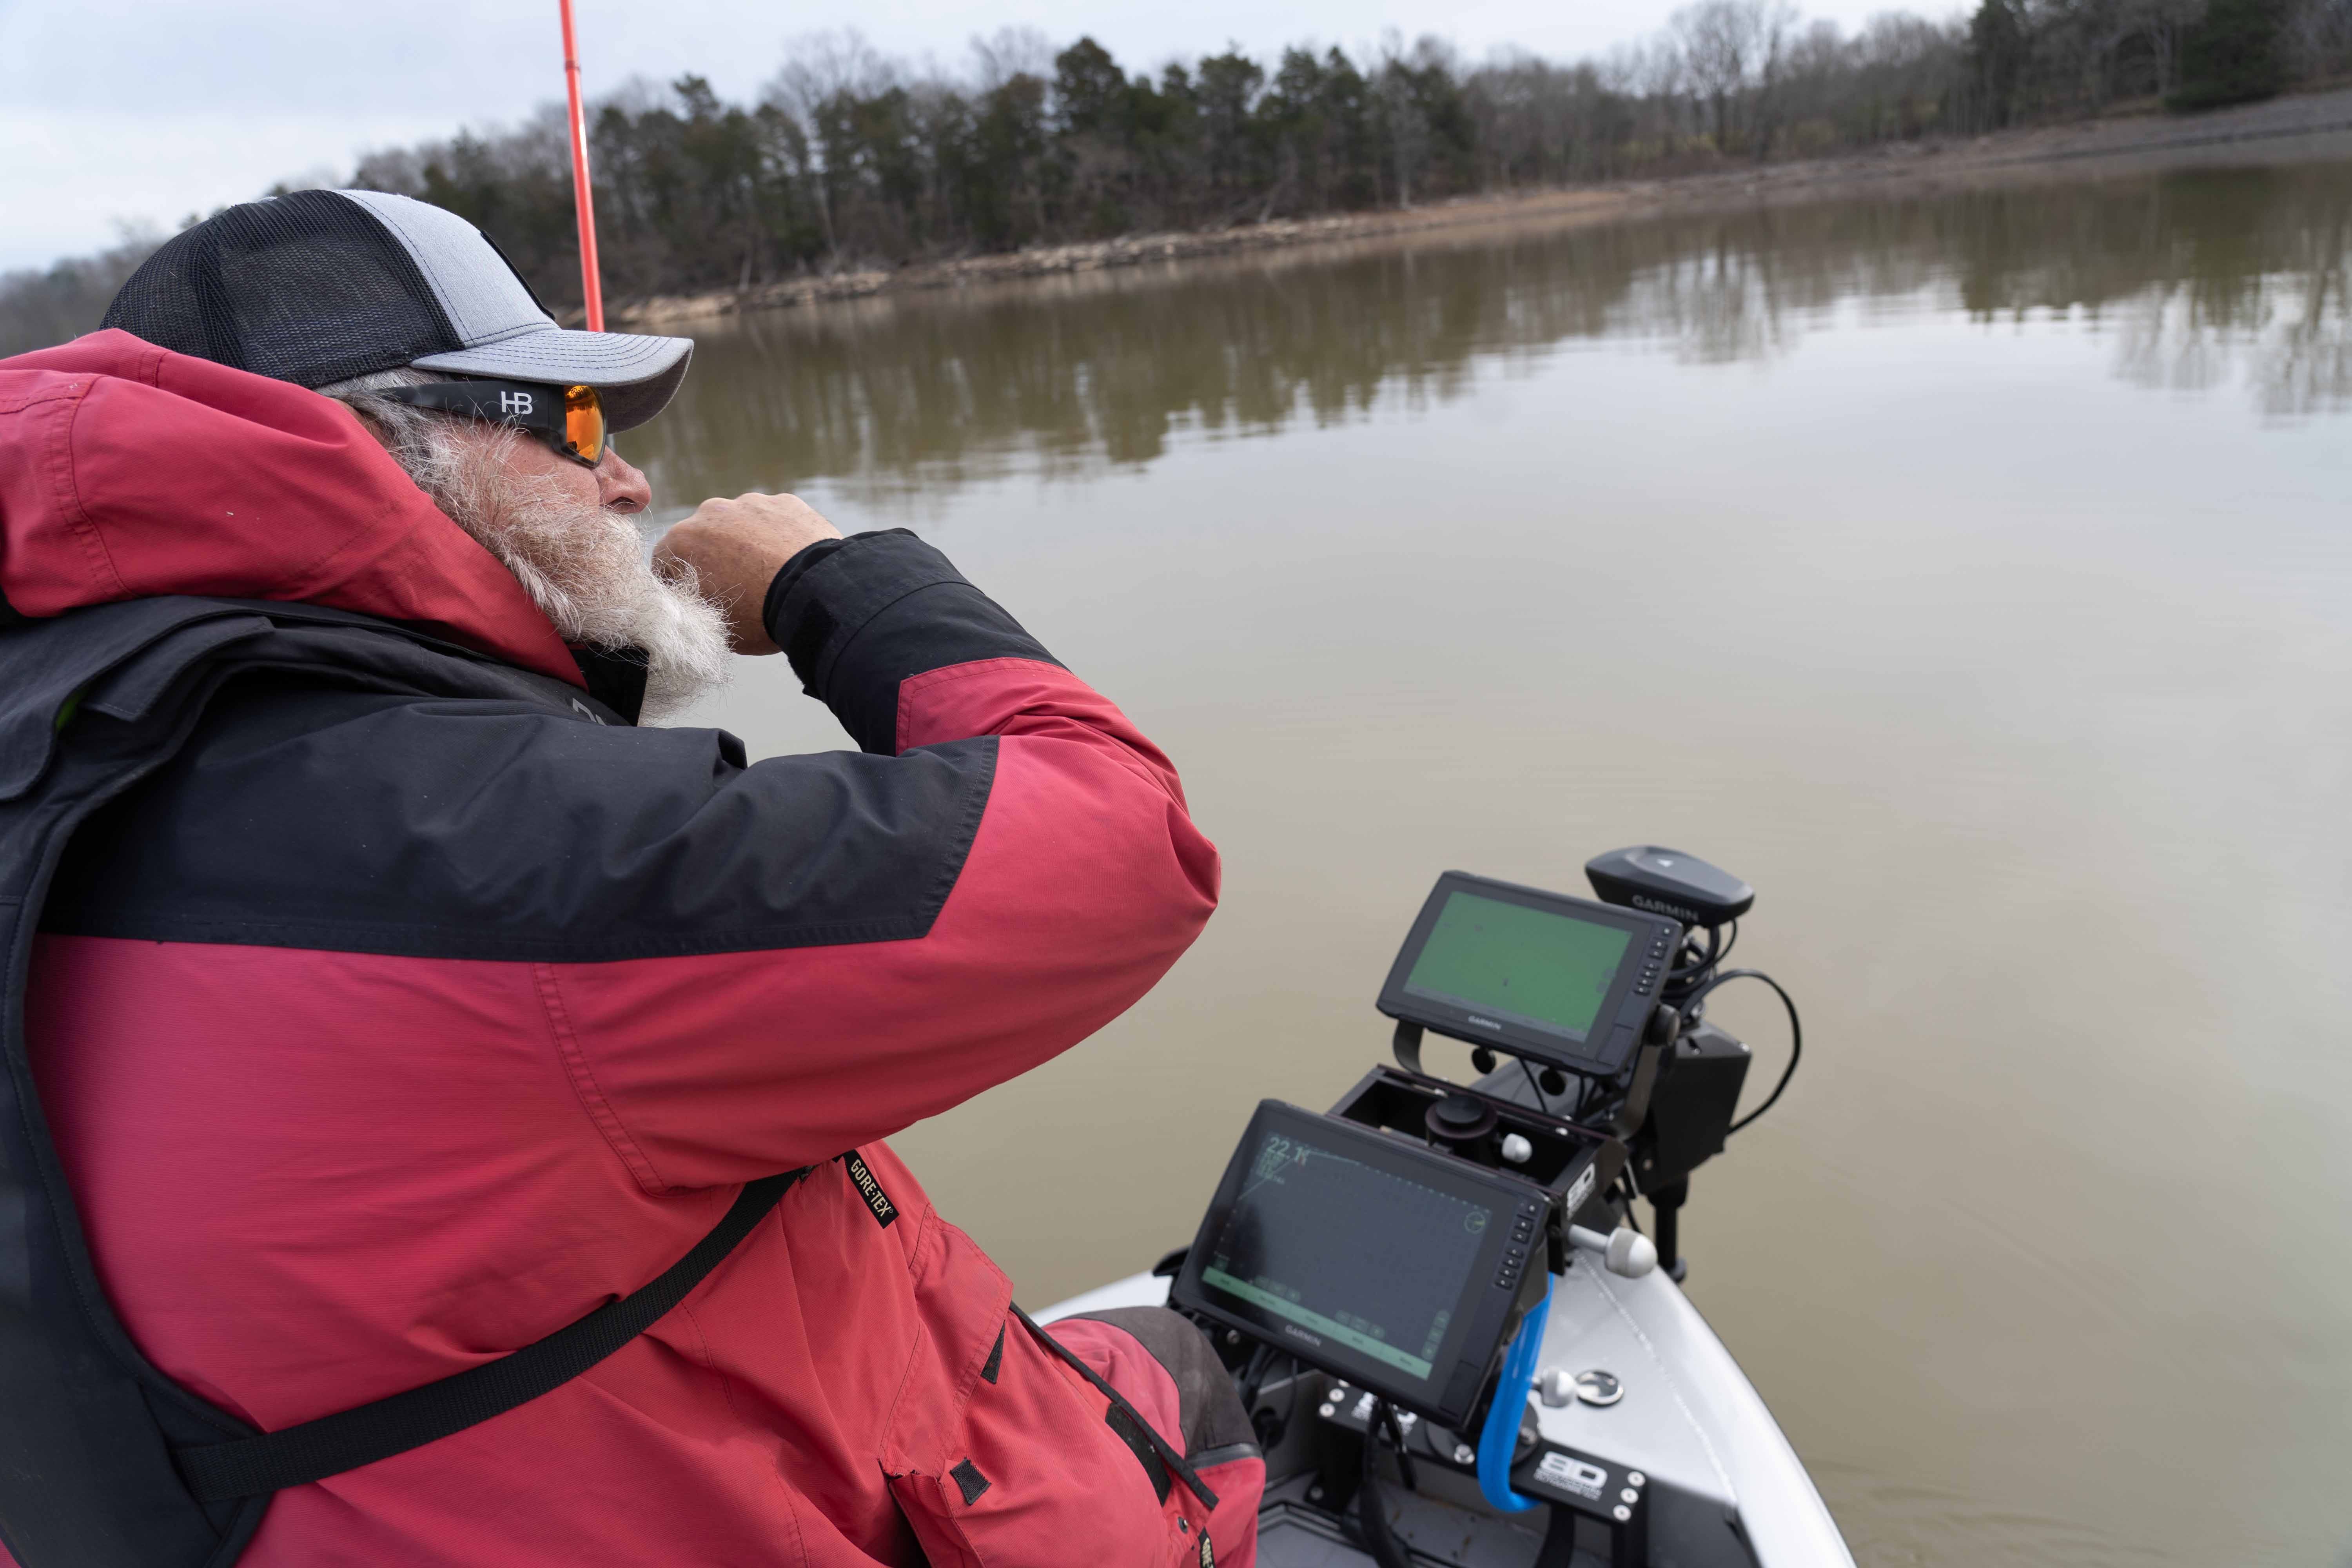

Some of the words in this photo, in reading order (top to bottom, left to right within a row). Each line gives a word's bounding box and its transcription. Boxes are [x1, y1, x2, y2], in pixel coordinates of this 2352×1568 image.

[1632, 895, 1699, 921] GARMIN
[1468, 1016, 1501, 1030] GARMIN
[1285, 1325, 1321, 1347] GARMIN
